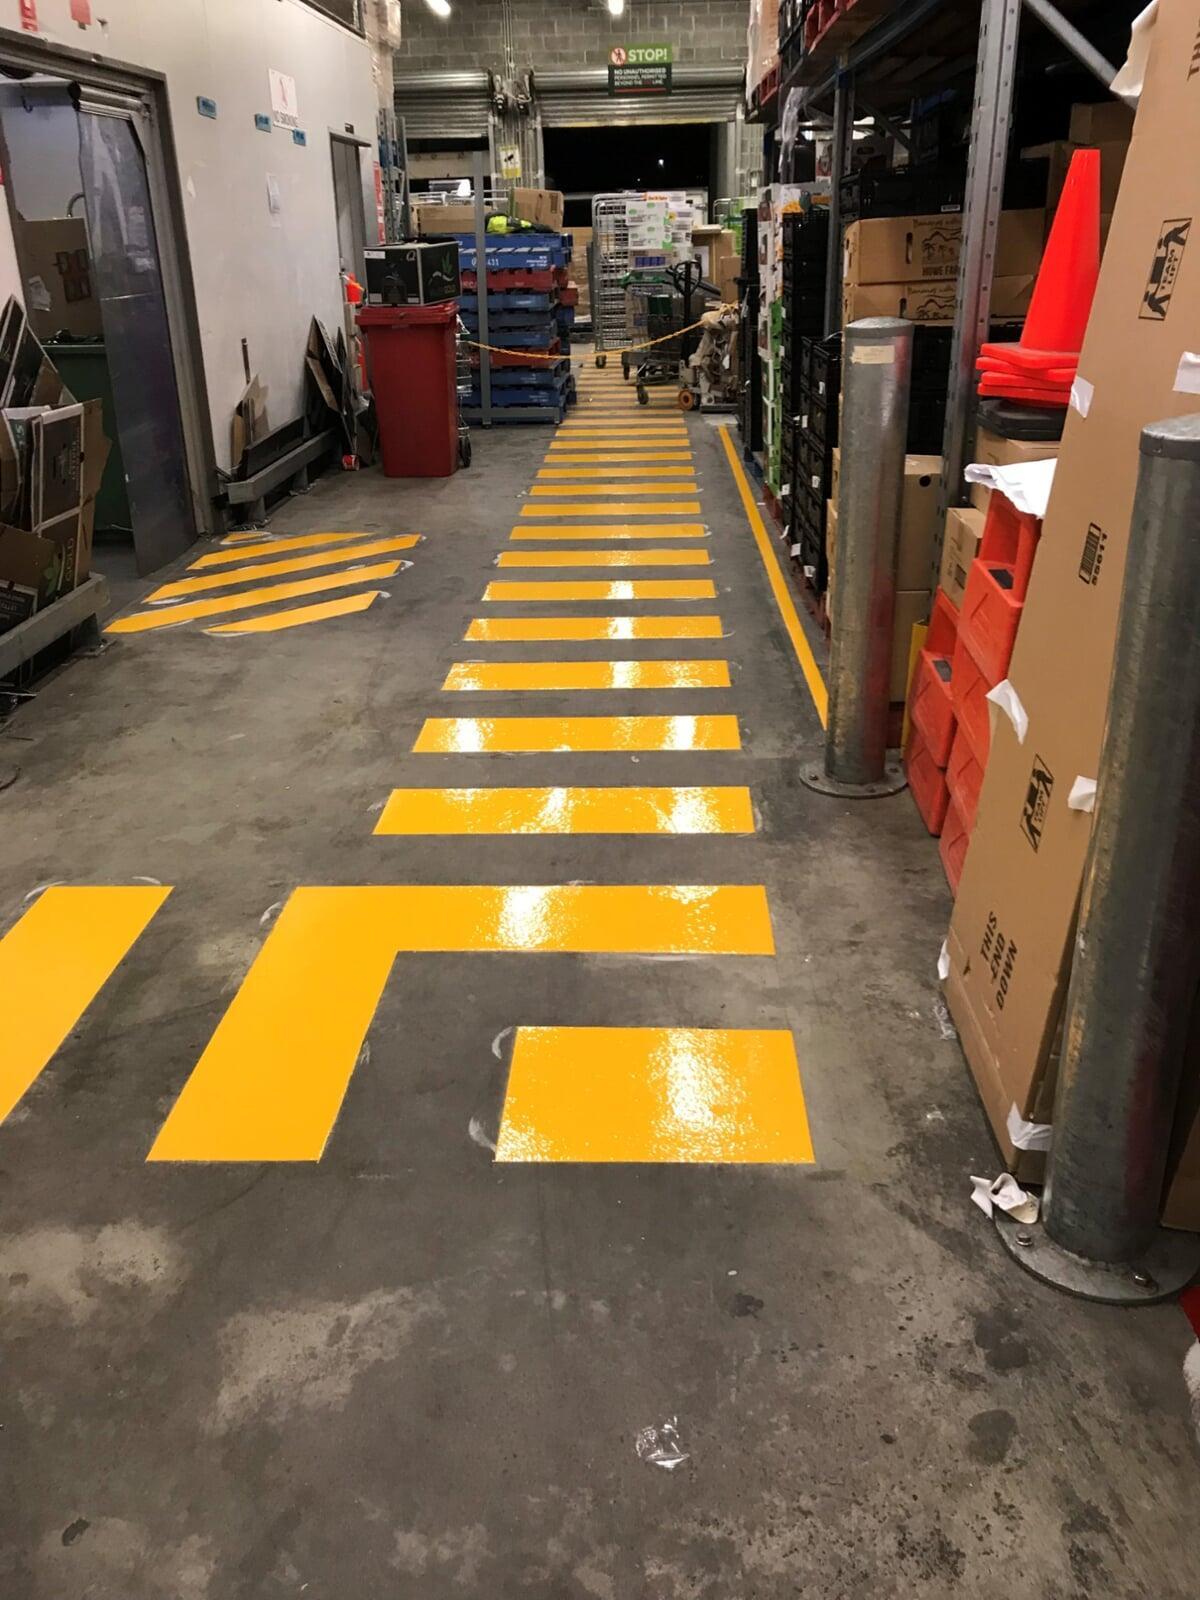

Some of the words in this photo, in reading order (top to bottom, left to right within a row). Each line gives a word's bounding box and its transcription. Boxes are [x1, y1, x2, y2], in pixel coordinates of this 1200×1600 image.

[628, 47, 668, 62] STOP!
[1161, 249, 1176, 290] TEAM
[1168, 257, 1179, 285] LIFT
[980, 910, 997, 962] THIS
[990, 931, 1006, 981] END
[995, 939, 1018, 1011] DOWN
